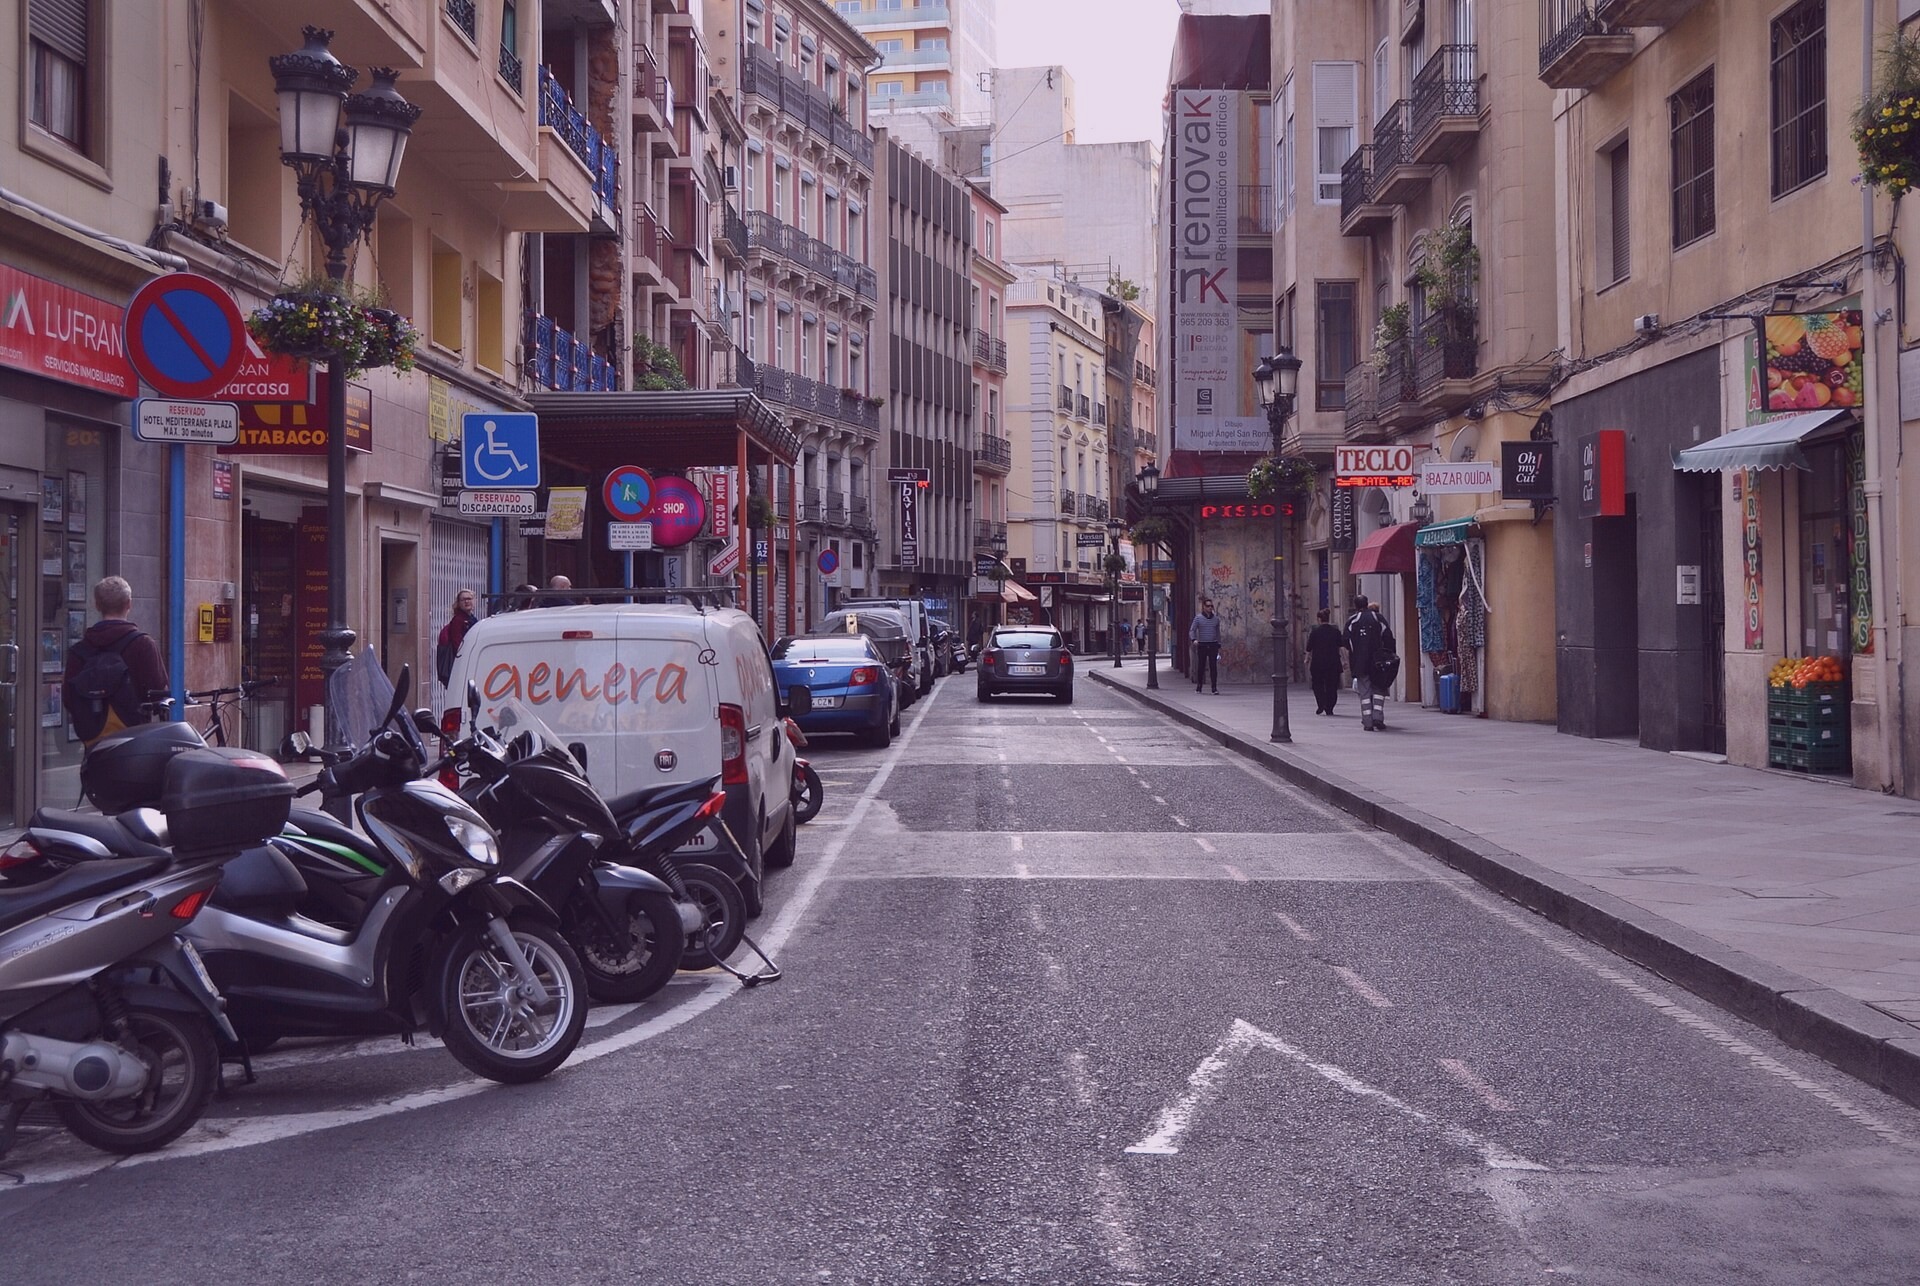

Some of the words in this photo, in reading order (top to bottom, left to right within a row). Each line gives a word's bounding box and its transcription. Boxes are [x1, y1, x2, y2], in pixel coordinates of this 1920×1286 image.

[1216, 95, 1228, 147] edificios
[1216, 150, 1228, 167] de
[1216, 171, 1228, 261] Rehabilitación
[45, 300, 123, 358] LUFRAN
[1180, 318, 1195, 326] 965
[1197, 318, 1212, 326] 209
[1214, 318, 1230, 326] 363
[1195, 334, 1228, 343] GRUPO
[45, 354, 80, 376] SERVICIOS
[79, 365, 125, 388] INMOBILIARIOS
[168, 405, 206, 417] RESERVADO
[143, 415, 164, 426] HOTEL
[165, 416, 212, 428] MEDITERRANEA
[213, 419, 232, 429] PLAZA
[1224, 420, 1243, 428] Dibujo
[181, 427, 189, 437] 30
[190, 428, 214, 438] minutos
[1190, 429, 1214, 439] Miguel
[1215, 429, 1235, 439] Ángel
[1236, 429, 1251, 438] San
[1208, 440, 1237, 448] Arquitecto
[1238, 439, 1260, 447] Técnico
[1338, 449, 1412, 472] TECLO
[1517, 452, 1536, 464] Oh
[1583, 443, 1593, 466] Oh
[1516, 473, 1537, 483] Cut
[1518, 466, 1536, 476] my
[1430, 472, 1463, 486] BAZAR
[715, 477, 726, 499] SEX
[473, 493, 521, 503] RESERVADO
[461, 503, 533, 514] DISCAPACITADOS
[663, 502, 685, 514] SHOP
[1333, 489, 1342, 539] CORTINAS
[1343, 489, 1352, 539] ARTESOL
[715, 504, 726, 535] SHOP
[1851, 432, 1869, 646] VERDURAS
[1745, 470, 1758, 632] FRUTAS
